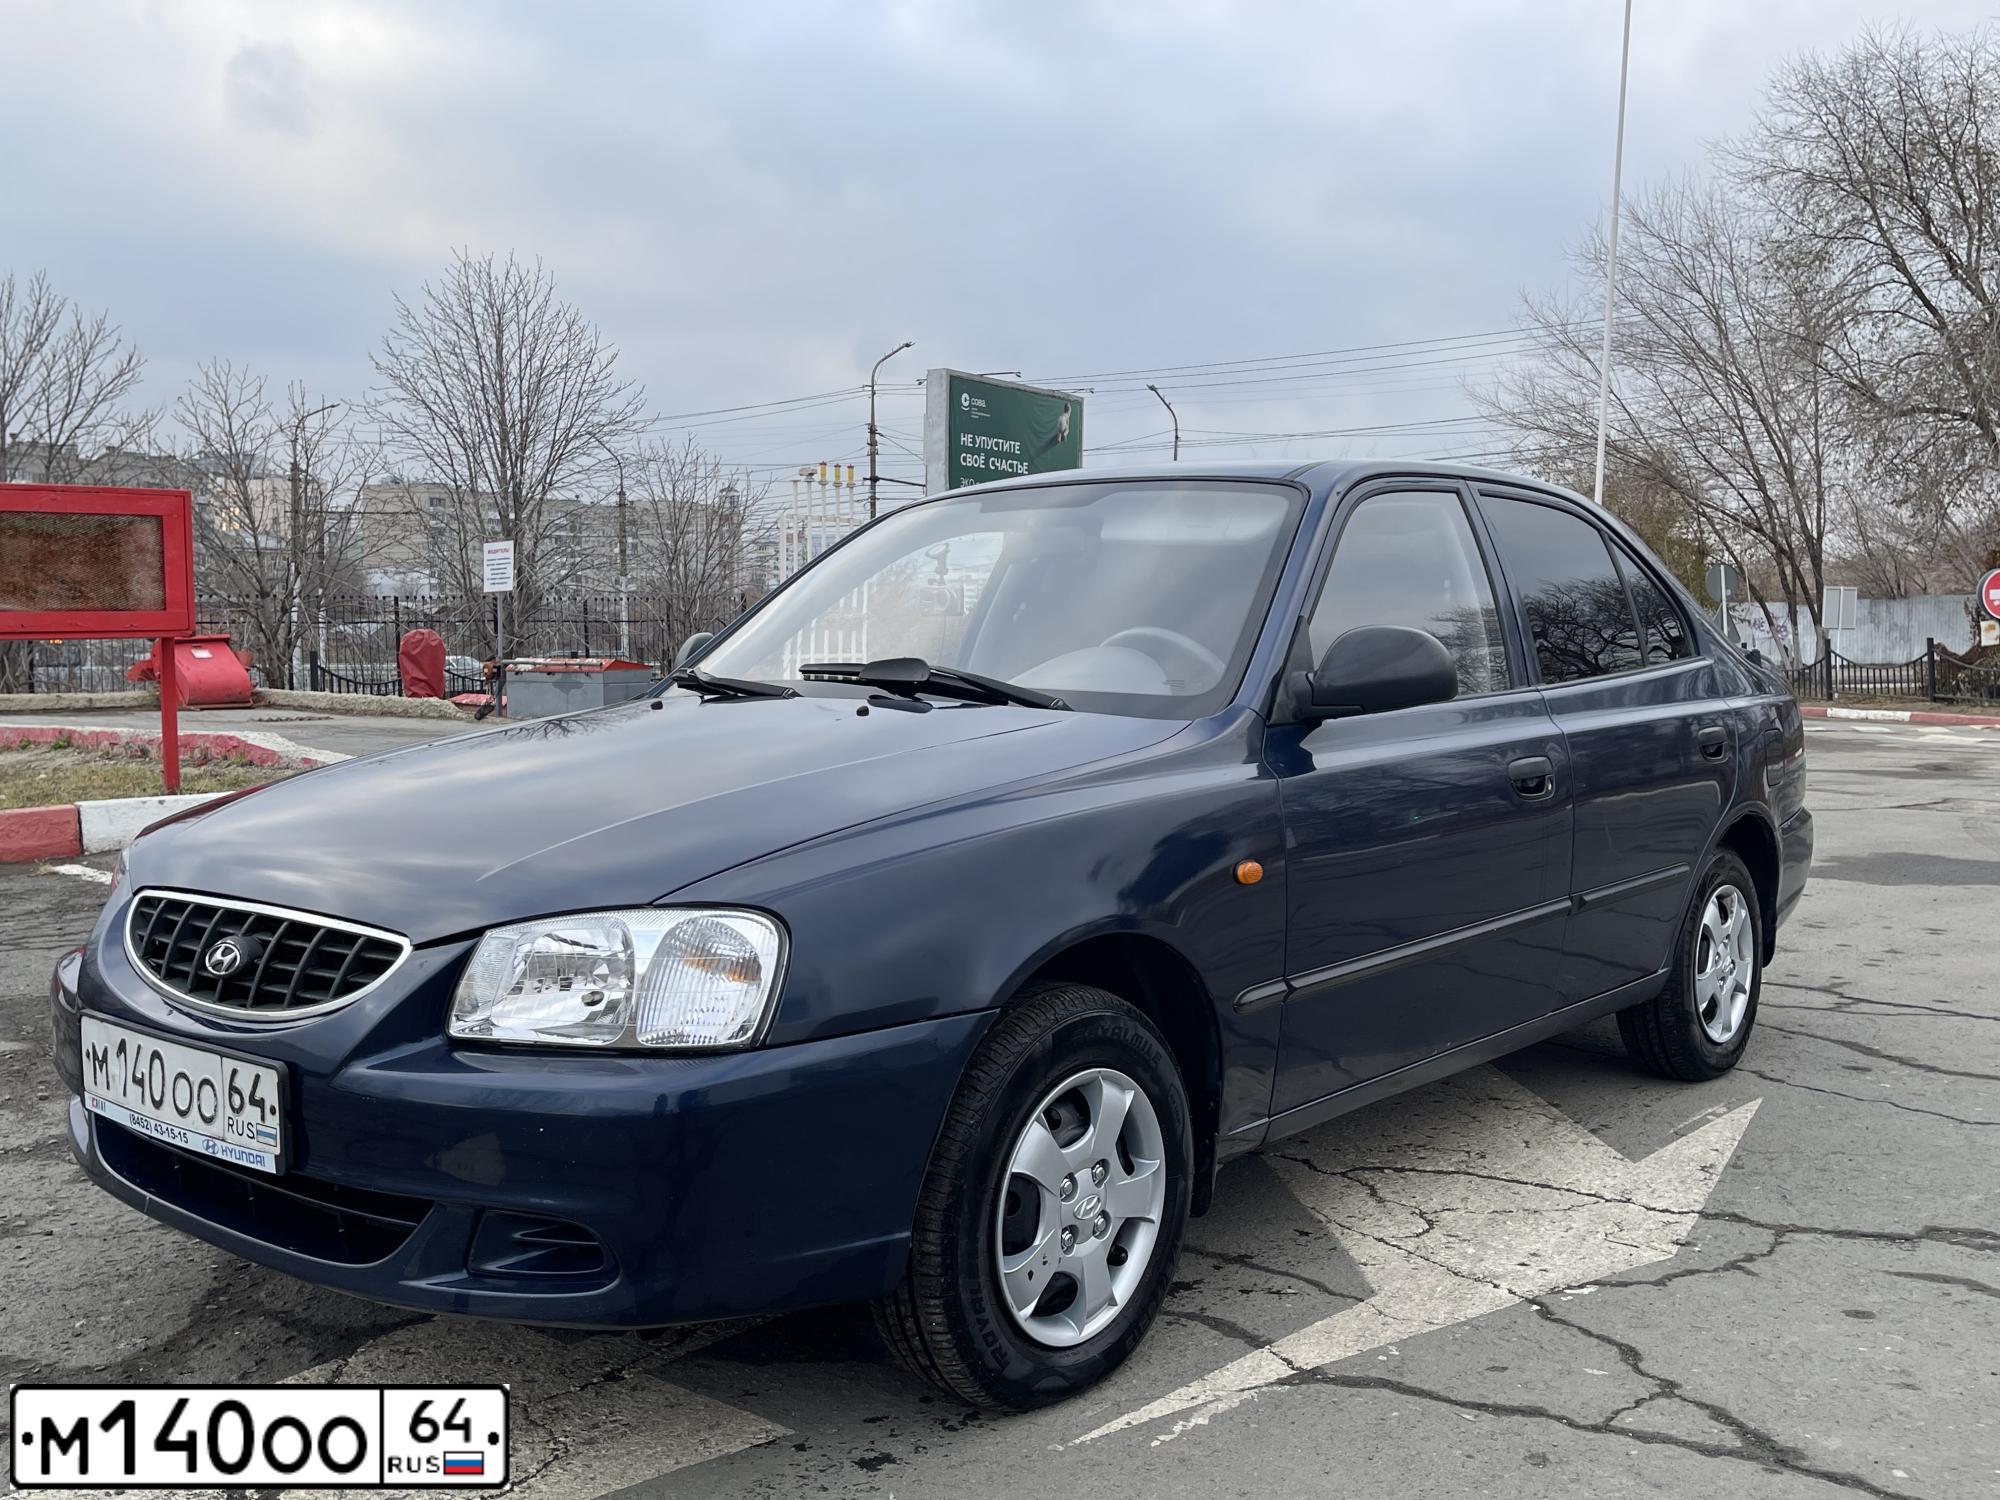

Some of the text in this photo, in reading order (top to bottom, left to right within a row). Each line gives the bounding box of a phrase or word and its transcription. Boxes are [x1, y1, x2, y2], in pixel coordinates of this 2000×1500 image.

[960, 432, 1020, 454] НЕ УПУСТИТЕ
[960, 453, 1029, 474] СВОЁ СЧАСТЬЕ
[228, 1067, 266, 1123] 64
[129, 1114, 189, 1144] (8452) 43-15-15
[227, 1116, 256, 1140] RUS
[220, 1145, 266, 1168] HYUNDAI
